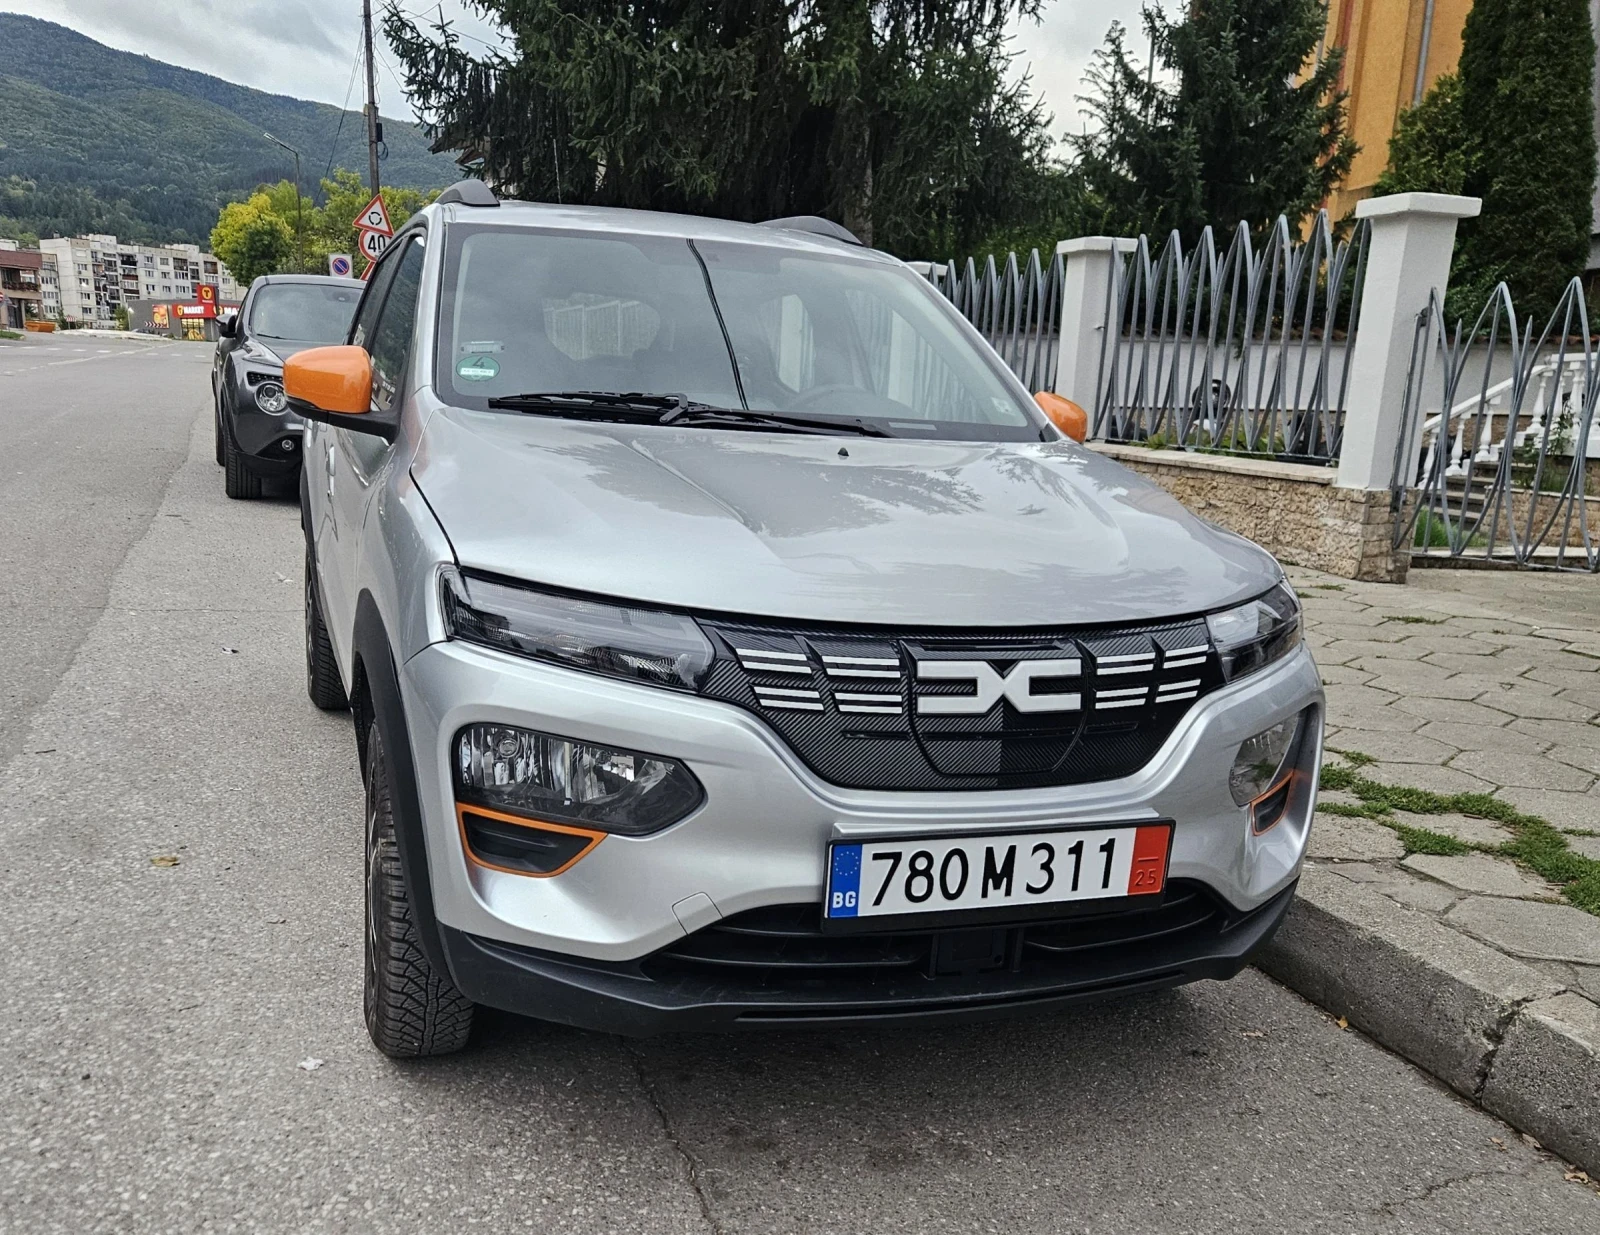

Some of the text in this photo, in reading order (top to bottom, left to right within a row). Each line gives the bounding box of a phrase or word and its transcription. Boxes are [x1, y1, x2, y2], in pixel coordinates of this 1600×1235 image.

[368, 234, 386, 252] 40
[183, 306, 204, 314] MARKET
[472, 356, 485, 368] 4
[1134, 868, 1157, 886] 25
[832, 891, 856, 909] BG
